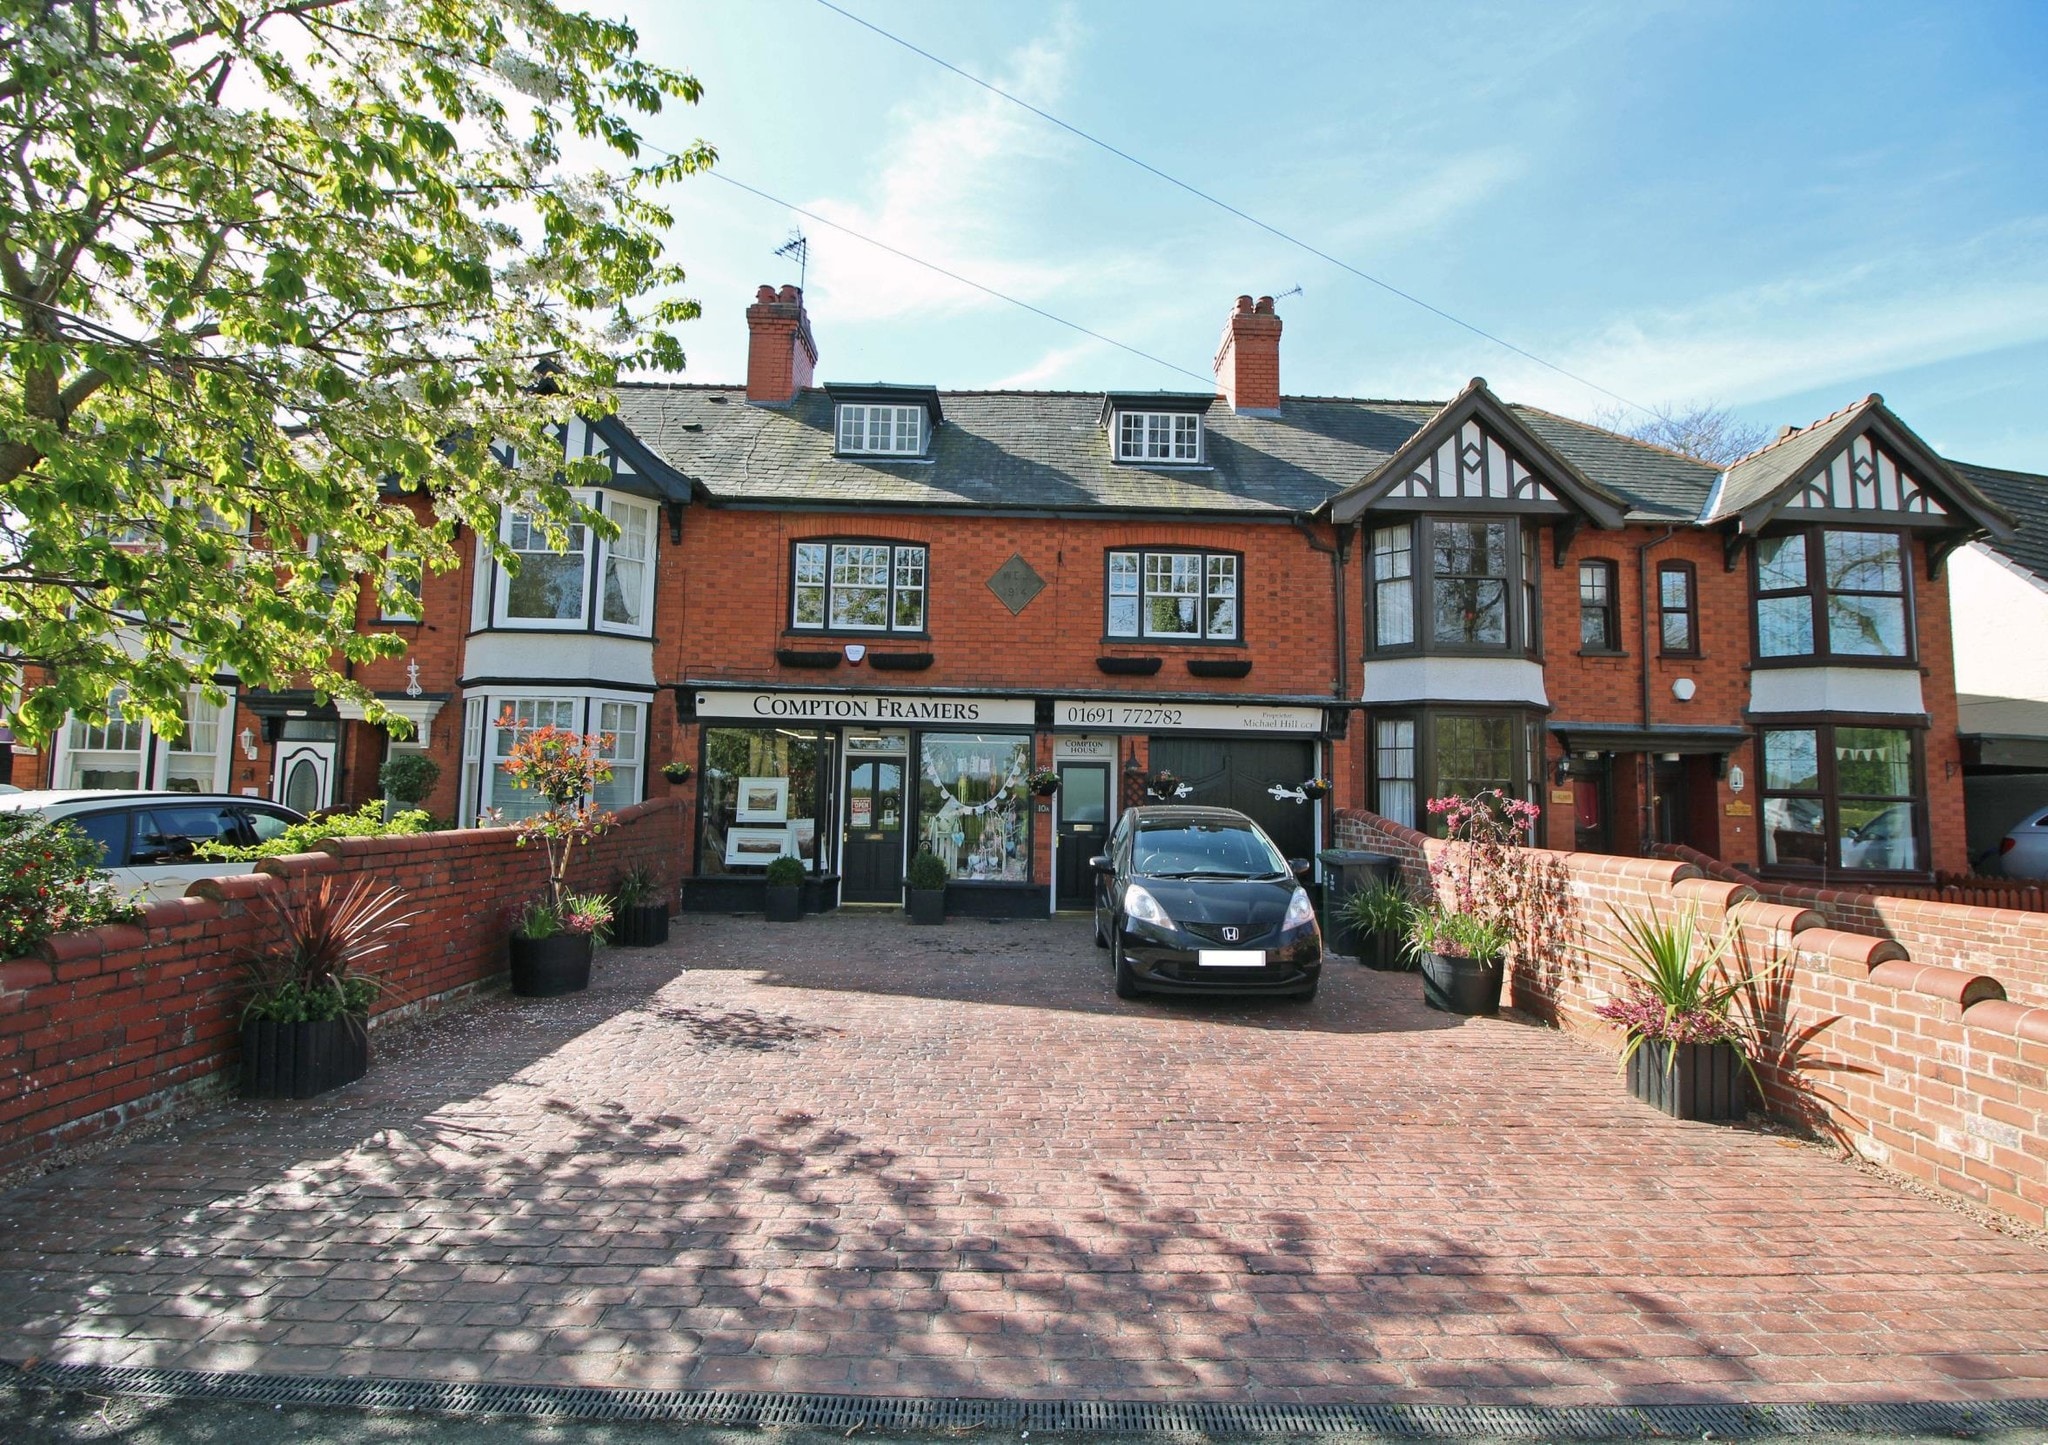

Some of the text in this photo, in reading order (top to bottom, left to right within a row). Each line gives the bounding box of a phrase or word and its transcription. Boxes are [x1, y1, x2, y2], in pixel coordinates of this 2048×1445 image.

[753, 695, 979, 720] COMPTON FRAMERS
[1068, 706, 1182, 725] 01691 772782
[1243, 719, 1277, 728] Michael
[1280, 720, 1298, 728] Hill
[1065, 740, 1103, 748] COMPTON
